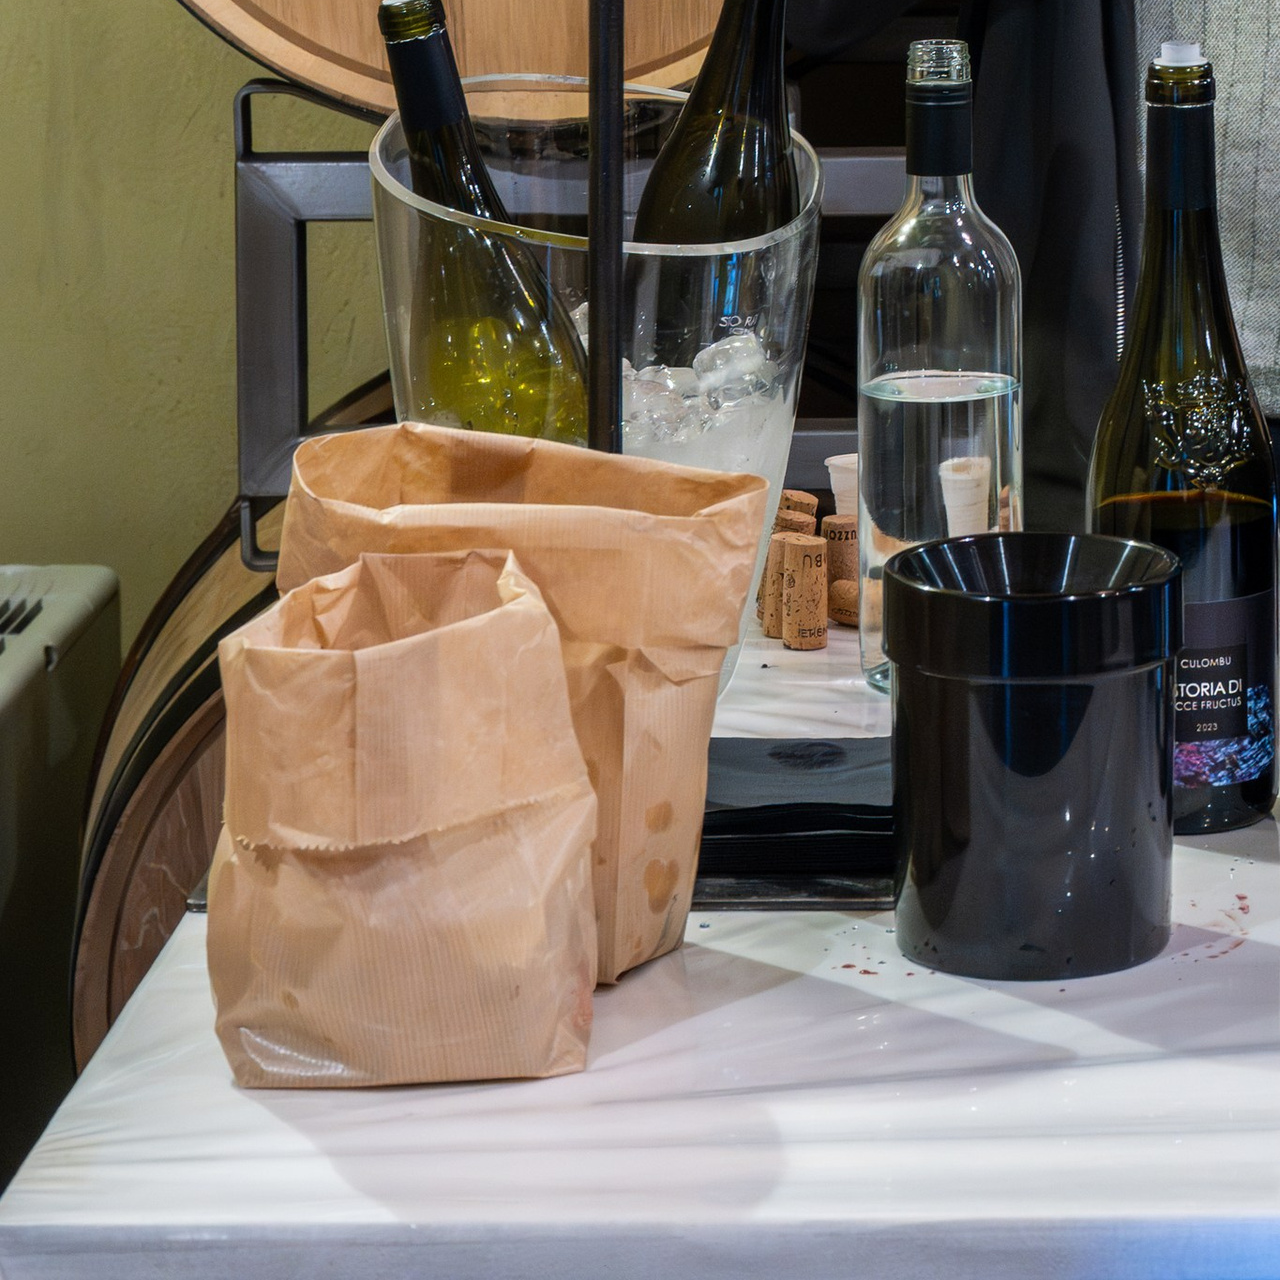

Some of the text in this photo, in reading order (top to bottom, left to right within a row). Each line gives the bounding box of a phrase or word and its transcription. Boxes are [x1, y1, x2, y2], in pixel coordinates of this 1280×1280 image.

[1180, 656, 1232, 669] CULOMBU
[1228, 678, 1243, 694] DI
[1175, 696, 1242, 711] CCE FRUCTUS
[1196, 722, 1218, 733] 2023
